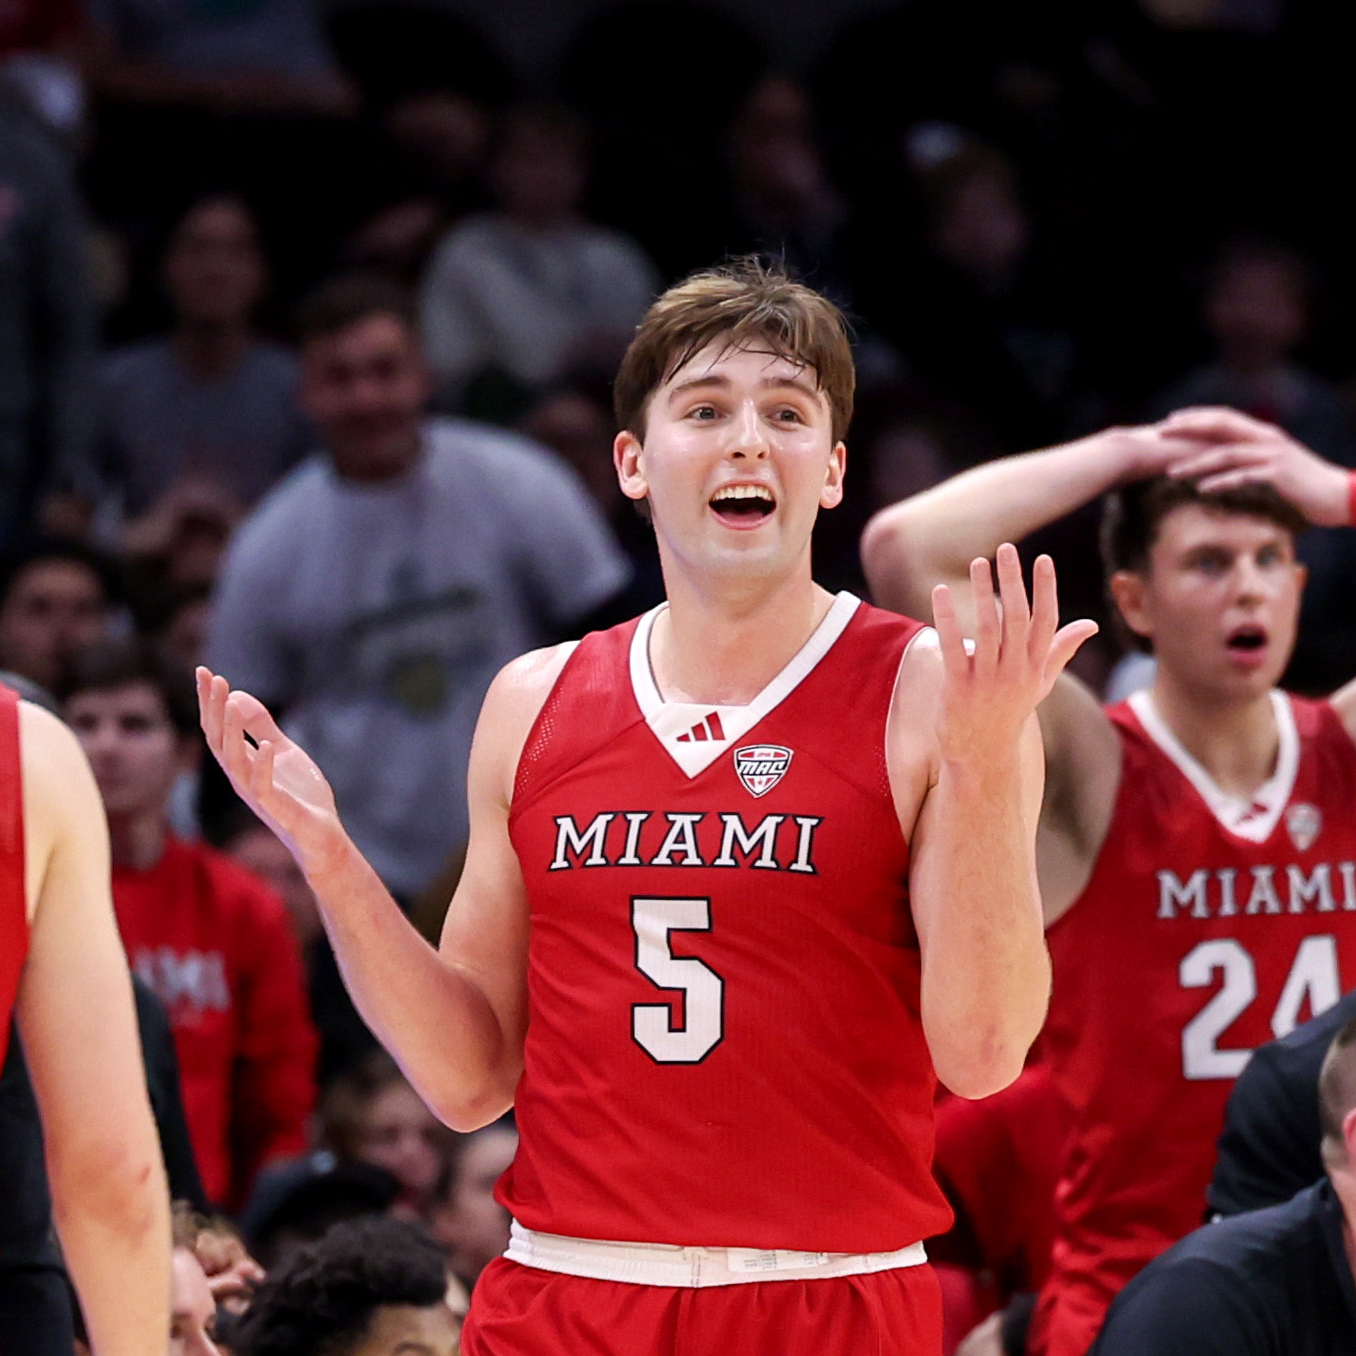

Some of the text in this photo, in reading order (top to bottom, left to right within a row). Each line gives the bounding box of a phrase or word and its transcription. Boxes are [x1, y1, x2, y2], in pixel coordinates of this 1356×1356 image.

[738, 761, 787, 775] MAC
[547, 811, 825, 876] MIAMI
[630, 896, 725, 1065] 5
[1179, 933, 1343, 1081] 24
